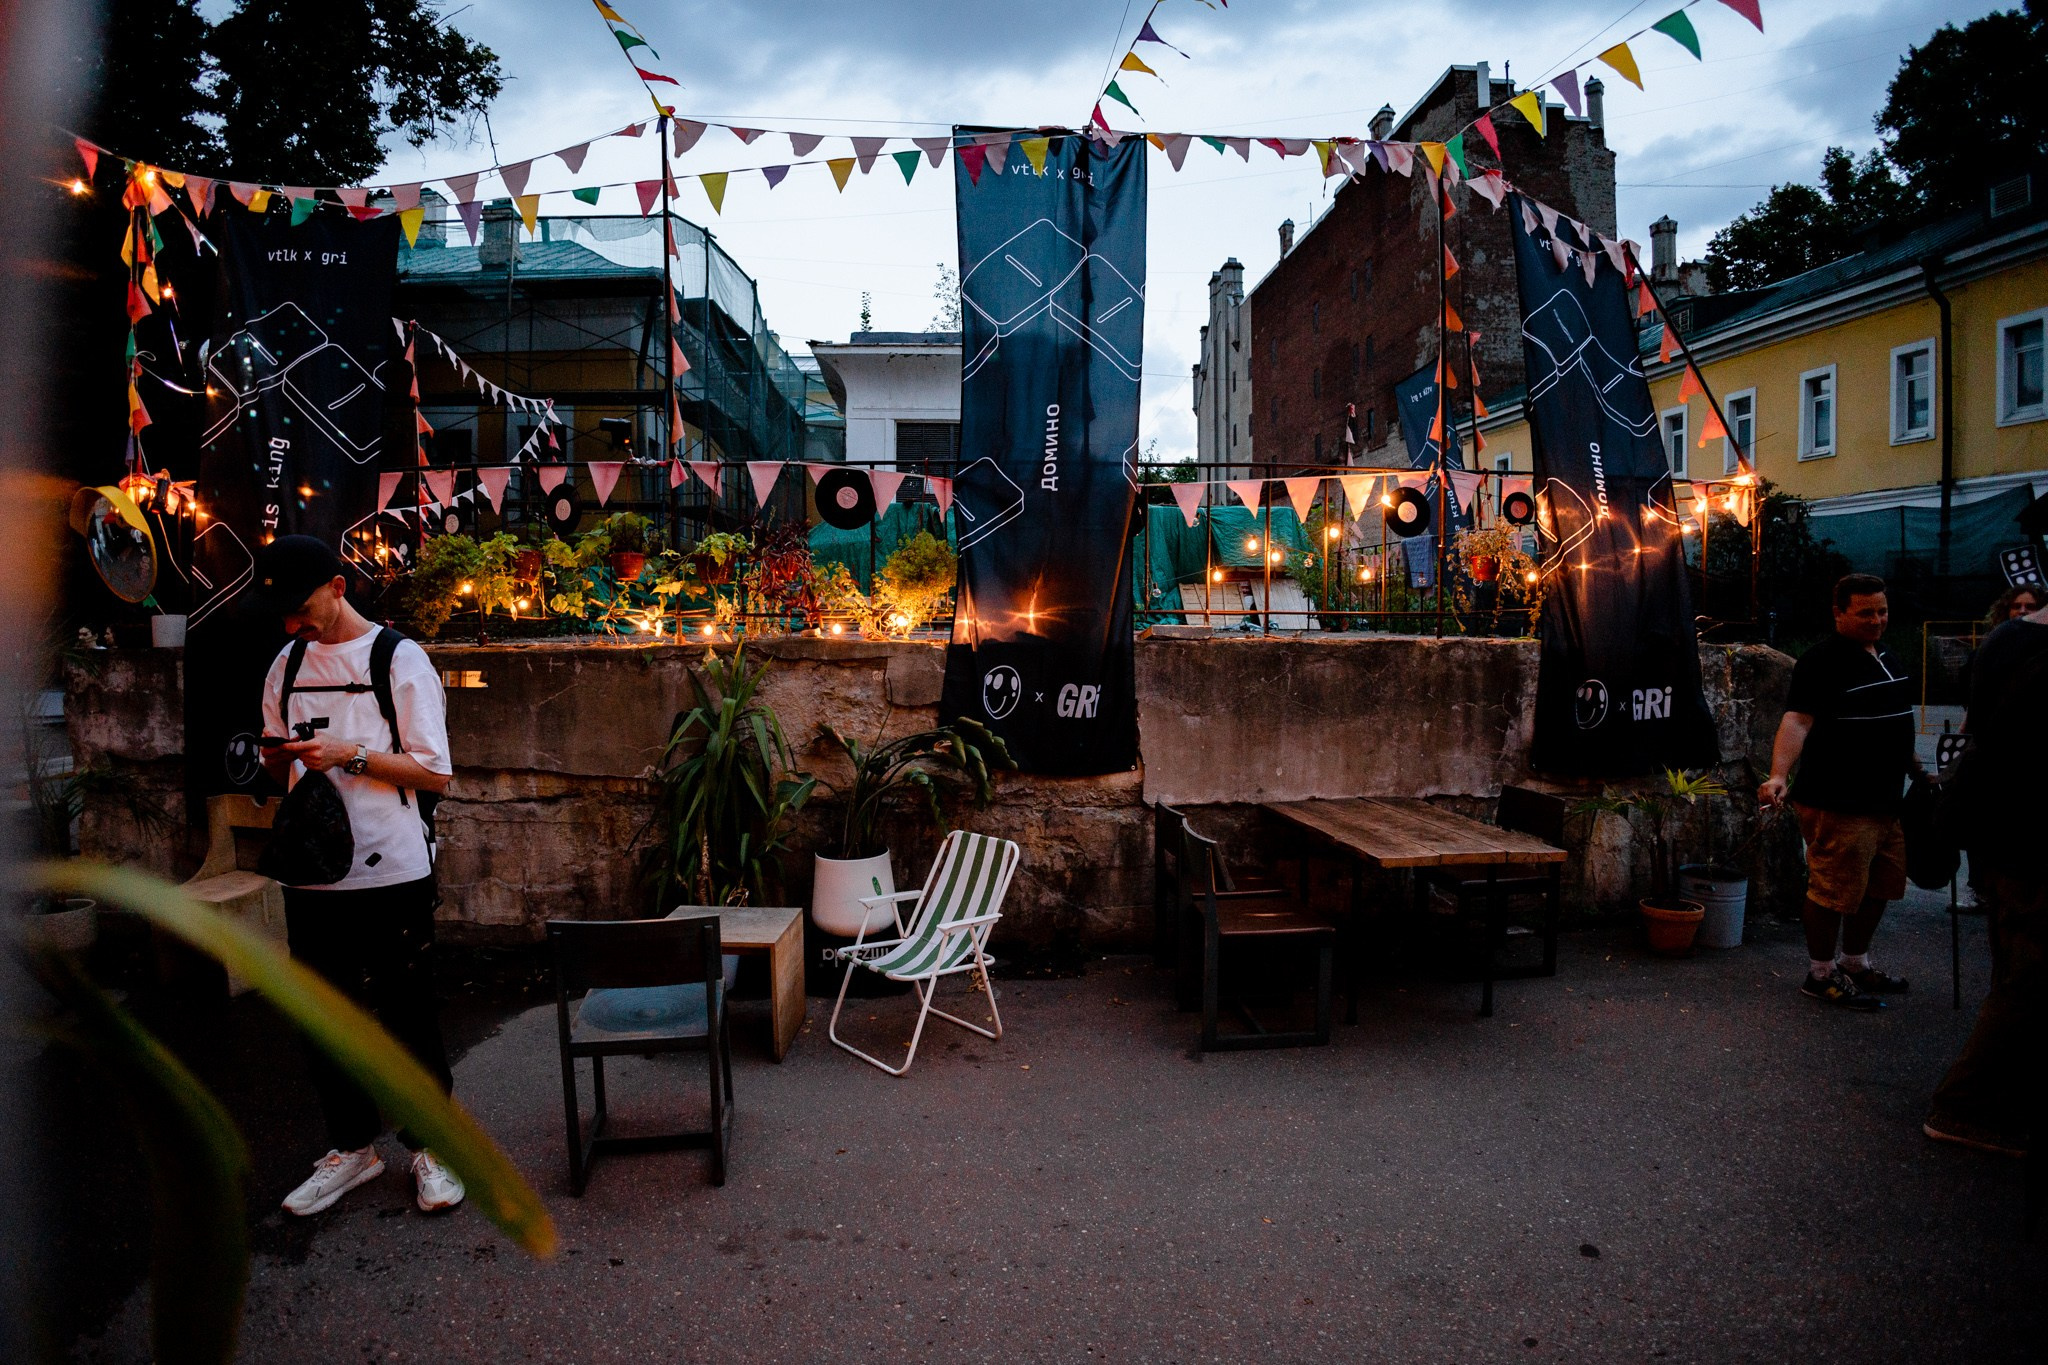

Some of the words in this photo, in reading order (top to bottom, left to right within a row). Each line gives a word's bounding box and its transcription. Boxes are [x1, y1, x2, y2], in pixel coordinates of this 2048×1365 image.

[1056, 168, 1065, 180] x
[267, 248, 298, 262] vtlk
[303, 250, 313, 261] x
[321, 251, 348, 265] gri
[266, 436, 291, 489] king
[261, 503, 280, 529] is
